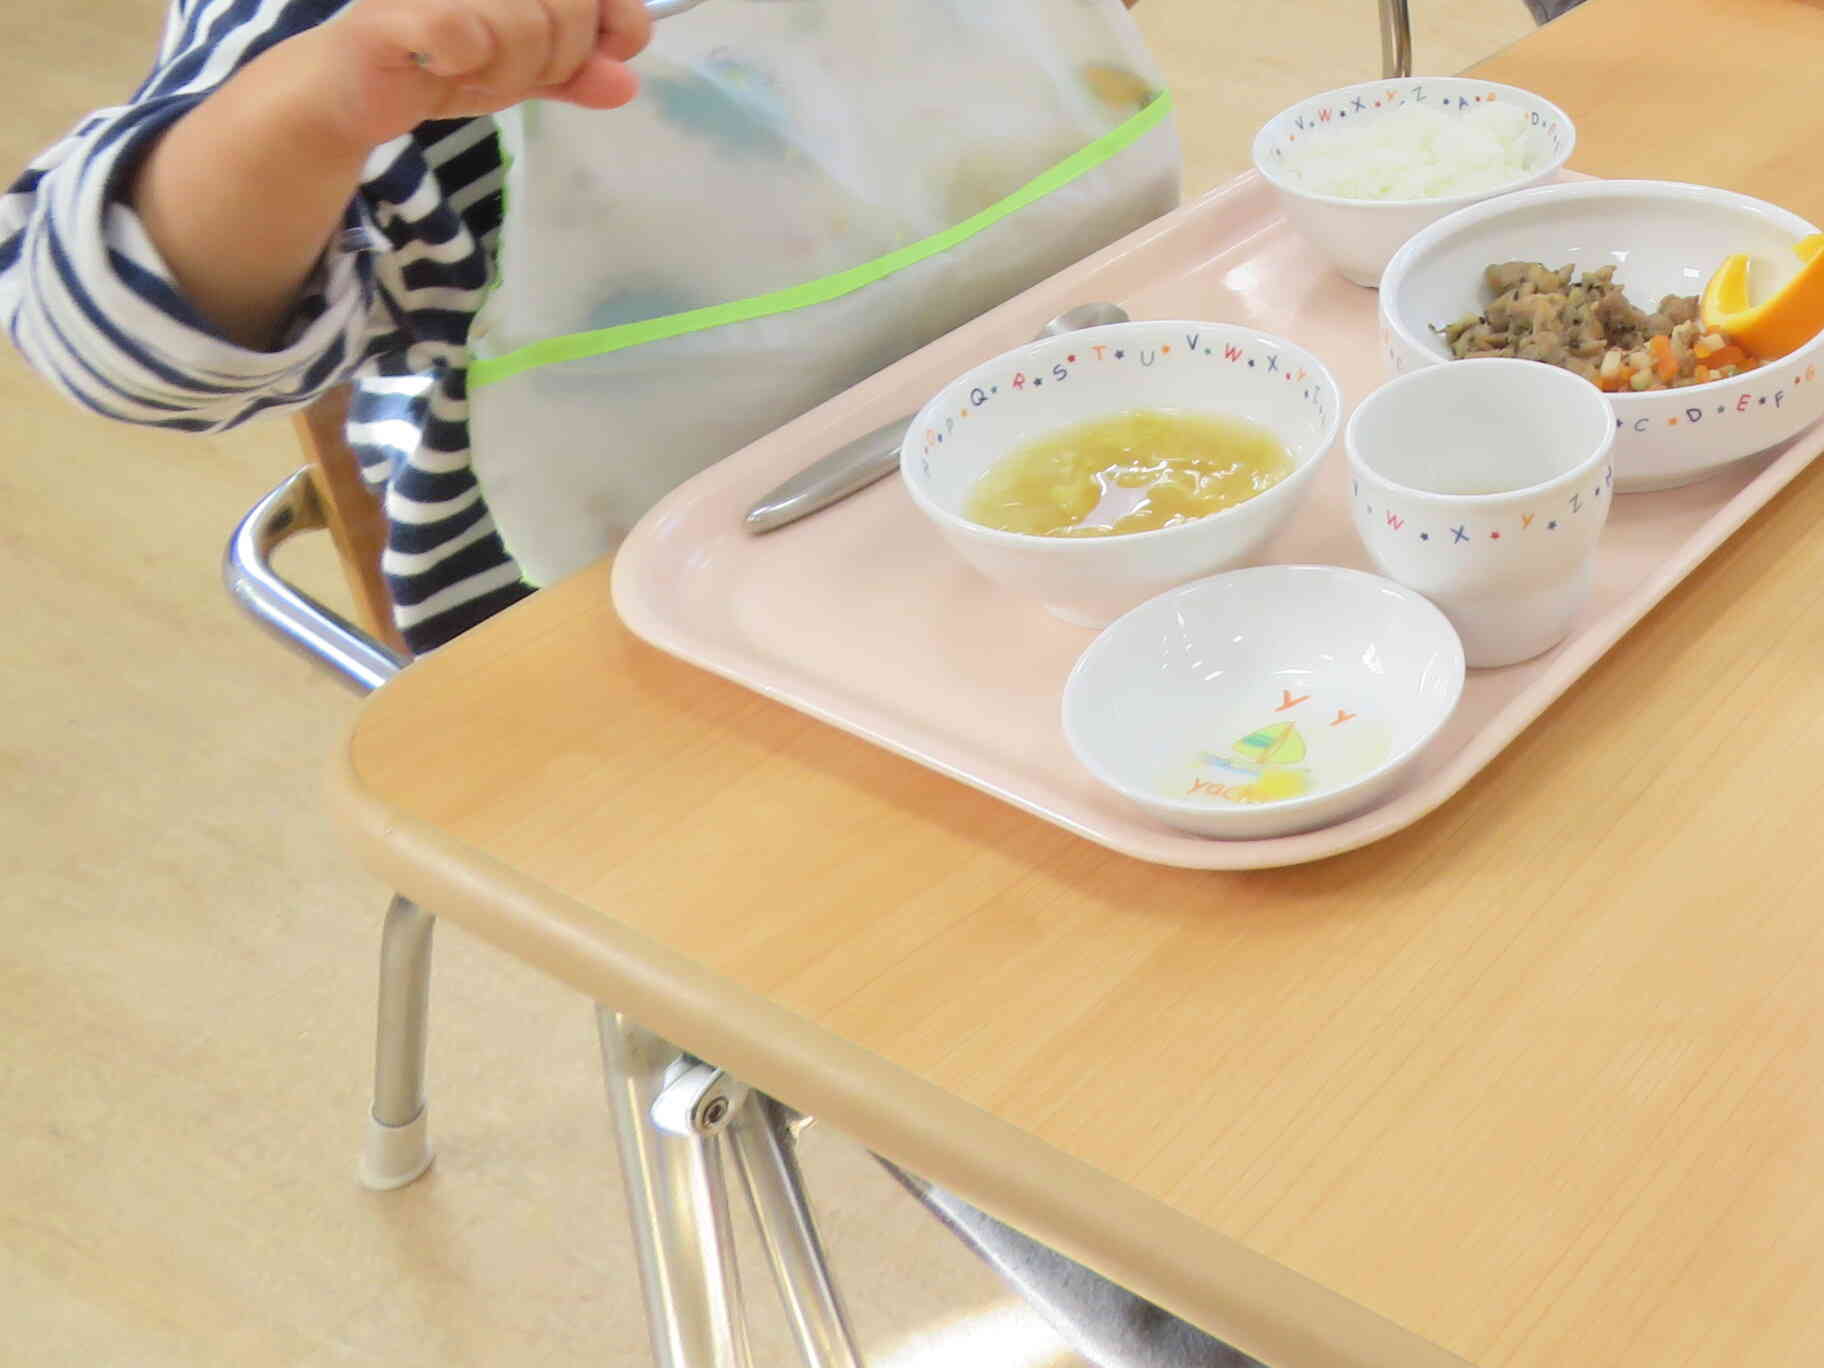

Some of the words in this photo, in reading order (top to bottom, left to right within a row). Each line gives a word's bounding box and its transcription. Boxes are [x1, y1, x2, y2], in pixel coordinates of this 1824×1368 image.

[1317, 108, 1332, 123] W
[1350, 96, 1366, 113] X
[1411, 86, 1426, 103] Z
[970, 387, 988, 407] Q
[1012, 372, 1025, 390] R
[1052, 364, 1068, 382] S
[1090, 345, 1106, 360] T
[1140, 350, 1155, 367] U
[1186, 334, 1199, 351] V
[1224, 342, 1243, 363] W
[1266, 355, 1278, 372] X
[1634, 418, 1649, 432] C
[1686, 408, 1702, 422] D
[1736, 394, 1752, 412] E
[1775, 390, 1784, 408] F
[1386, 510, 1404, 530] W
[1450, 524, 1470, 544] X
[1521, 512, 1534, 529] Y
[1569, 493, 1582, 513] Z
